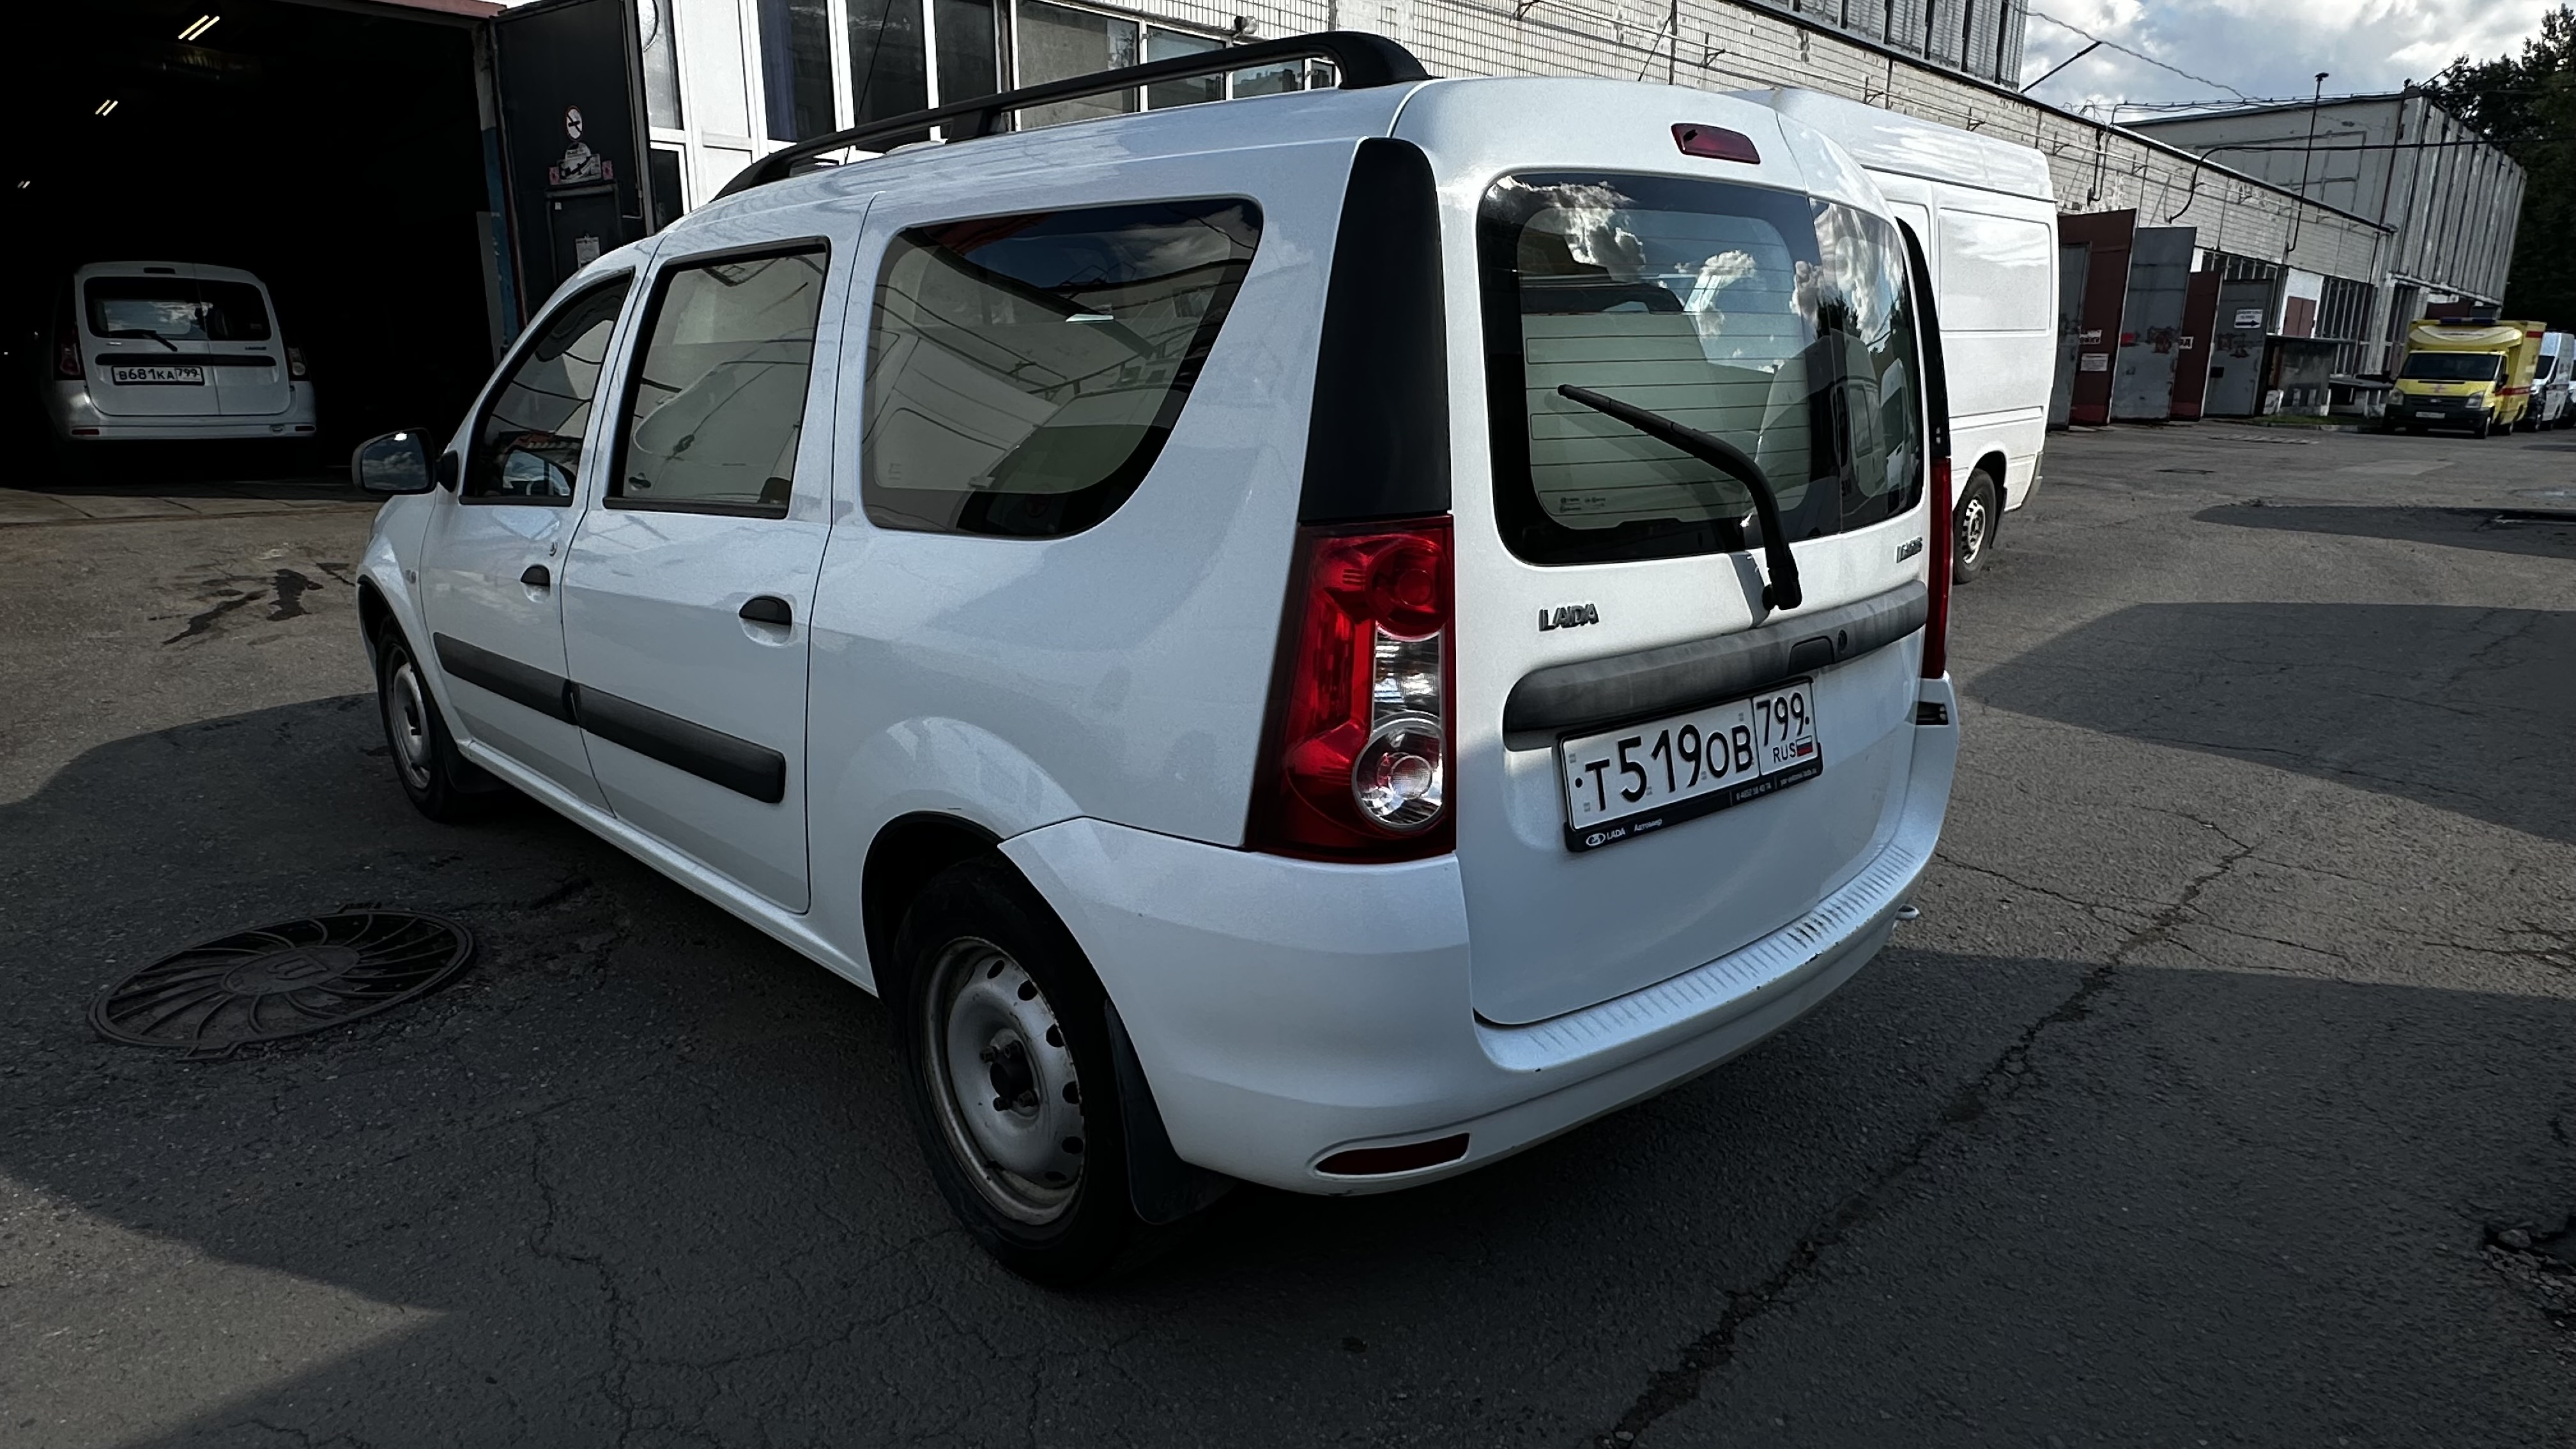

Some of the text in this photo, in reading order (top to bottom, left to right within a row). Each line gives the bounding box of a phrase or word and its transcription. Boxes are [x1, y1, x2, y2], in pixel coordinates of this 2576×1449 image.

[119, 367, 198, 380] В681КА 799
[1538, 603, 1599, 631] LADA
[1584, 692, 1805, 812] Т519ОВ 799
[1773, 742, 1796, 764] RUS
[1606, 827, 1626, 841] LADA
